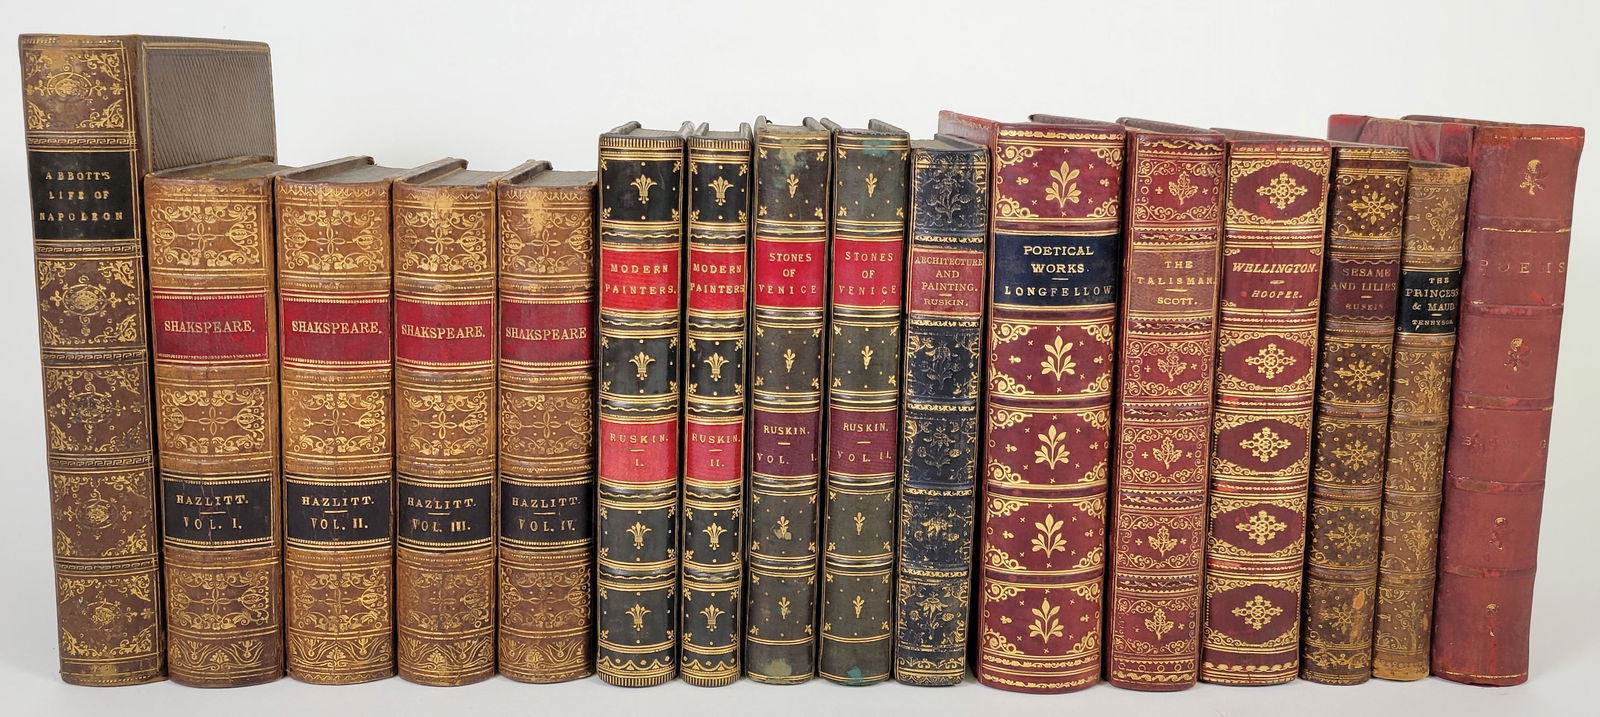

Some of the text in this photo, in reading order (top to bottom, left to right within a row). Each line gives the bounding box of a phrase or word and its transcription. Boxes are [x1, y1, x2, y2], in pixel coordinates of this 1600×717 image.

[45, 172, 111, 180] ABBOTT'S
[49, 191, 109, 200] LIFE OF
[39, 212, 123, 221] NAPOLEON
[1024, 246, 1094, 256] POETICAL
[769, 253, 812, 262] STONES
[845, 252, 893, 262] STONES
[915, 257, 983, 266] ARCHITECTURE
[611, 264, 668, 274] MODERN
[693, 263, 742, 274] MODERN
[1031, 264, 1089, 273] WORKS.
[1165, 261, 1193, 269] THE
[1232, 263, 1317, 273] WELLINGTON.
[783, 269, 796, 278] OF
[862, 270, 875, 279] OF
[936, 270, 960, 278] AND
[1342, 268, 1391, 277] SESAME
[605, 283, 677, 295] PAINTERS.
[759, 284, 817, 294] VENICE
[839, 285, 897, 295] VENICE
[921, 282, 978, 291] PAINTING.
[1330, 282, 1396, 291] AND LILIES
[1251, 290, 1302, 298] HOOPER.
[1157, 297, 1198, 305] SCOTT.
[1412, 302, 1421, 310] &
[164, 319, 255, 333] SHAKSPEARE.
[292, 320, 383, 334] SHAKSPEARE.
[401, 325, 486, 339] SHAKSPEARE.
[505, 327, 586, 340] SHAKSPEARE
[763, 425, 810, 435] RUSKIN.
[843, 423, 888, 432] RUSKIN.
[610, 433, 668, 444] RUSKIN.
[692, 433, 741, 444] RUSKIN.
[757, 453, 817, 464] VOL. I.
[837, 451, 871, 462] VOL.
[635, 458, 644, 466] I.
[710, 459, 725, 467] II.
[176, 495, 248, 506] HAZLITT.
[302, 496, 374, 507] HAZLITT.
[407, 497, 477, 509] HAZLITT.
[512, 497, 581, 508] HAZLITT.
[184, 517, 242, 530] VOL. I.
[311, 518, 368, 531] VOL. II.
[412, 518, 443, 533] VOL.
[518, 519, 576, 532] VOL. IV.
